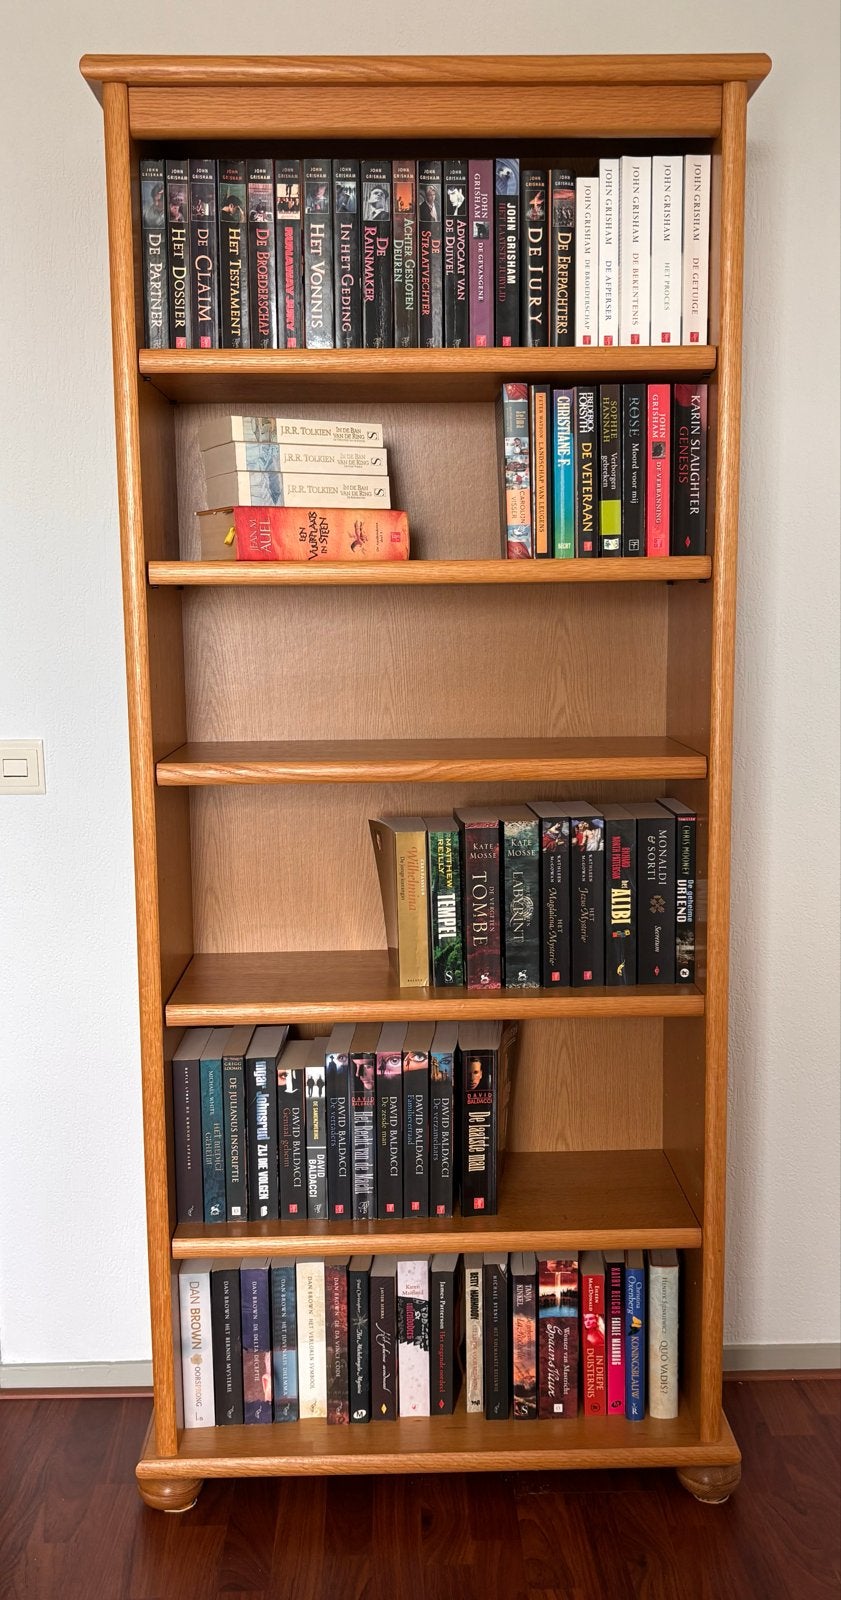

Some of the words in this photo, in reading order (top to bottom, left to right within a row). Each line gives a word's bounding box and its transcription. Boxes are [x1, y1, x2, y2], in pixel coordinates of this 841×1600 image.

[693, 163, 701, 192] JOHN
[507, 203, 516, 230] JOHN
[692, 194, 701, 241] GRISHAM
[172, 228, 185, 259] HET
[229, 228, 240, 255] HET
[311, 224, 325, 255] HET
[446, 236, 455, 275] DUIVEL
[285, 227, 293, 295] RUNAWAY
[364, 226, 376, 302] RAINMAKER
[507, 236, 515, 284] GRISHAM
[605, 260, 612, 273] DE
[692, 257, 699, 270] DE
[150, 263, 162, 328] PARTNER
[172, 266, 187, 328] DOSSIER
[195, 255, 212, 322] CLAIM
[230, 260, 241, 336] TESTAMENT
[257, 251, 269, 335] BROEDERSCHAP
[311, 261, 325, 328] VONNIS
[342, 274, 353, 331] GEDING
[457, 279, 465, 300] VAN
[528, 265, 543, 324] JURY
[557, 396, 571, 456] CHRISTIANE
[579, 393, 587, 433] FORSYTH
[586, 392, 594, 432] FREDERICK
[602, 397, 610, 442] HANNAH
[629, 397, 640, 438] ROSE
[691, 395, 700, 434] KARIN
[280, 426, 299, 435] J.R.R.
[300, 427, 331, 436] TOLKIEN
[557, 459, 570, 467] F.
[582, 443, 592, 459] DE
[631, 443, 639, 469] Moord
[656, 462, 661, 472] DE
[678, 426, 689, 483] GENESIS
[602, 456, 610, 487] gebreken
[610, 452, 618, 489] Verborgen
[690, 439, 700, 515] SLAUGHTER
[582, 463, 593, 531] VETERAAN
[630, 491, 639, 504] mij
[260, 519, 271, 552] AUEL
[299, 527, 307, 542] EEN
[319, 517, 329, 544] STEEN
[647, 835, 655, 843] &
[682, 826, 690, 844] CHRIS
[648, 847, 656, 880] SORTI
[658, 830, 667, 885] MONALDI
[407, 847, 419, 911] Wilhelmina
[489, 887, 494, 895] DE
[687, 880, 693, 888] De
[437, 893, 456, 939] TEMPEL
[472, 871, 488, 947] TOMBE
[509, 872, 524, 942] LABYRINT
[611, 888, 631, 924] ALIBI
[677, 880, 686, 923] VRIEND
[229, 1078, 237, 1089] DE
[229, 1092, 238, 1133] JULIANUS
[256, 1091, 270, 1140] Johnsrud
[355, 1111, 373, 1123] Het
[382, 1097, 388, 1107] De
[389, 1096, 397, 1127] DAVID
[469, 1111, 490, 1122] De
[258, 1144, 267, 1156] ZIJ
[355, 1125, 373, 1145] Recht
[469, 1125, 490, 1152] laatste
[231, 1135, 239, 1182] INSCRIPTIE
[258, 1158, 268, 1170] DIE
[317, 1154, 325, 1177] DAVID
[355, 1148, 370, 1160] van
[355, 1162, 373, 1170] de
[390, 1130, 398, 1176] BALDACCI
[469, 1154, 485, 1172] man
[258, 1172, 269, 1199] VOLGEN
[309, 1159, 317, 1198] BALDACCI
[355, 1173, 372, 1194] Macht
[189, 1281, 200, 1304] DAN
[191, 1308, 202, 1350] BROWN
[587, 1348, 595, 1398] DUISTERNIS
[596, 1355, 603, 1365] IN
[631, 1336, 639, 1399] KONINGSBLAUW
[660, 1364, 668, 1394] VADIS?
